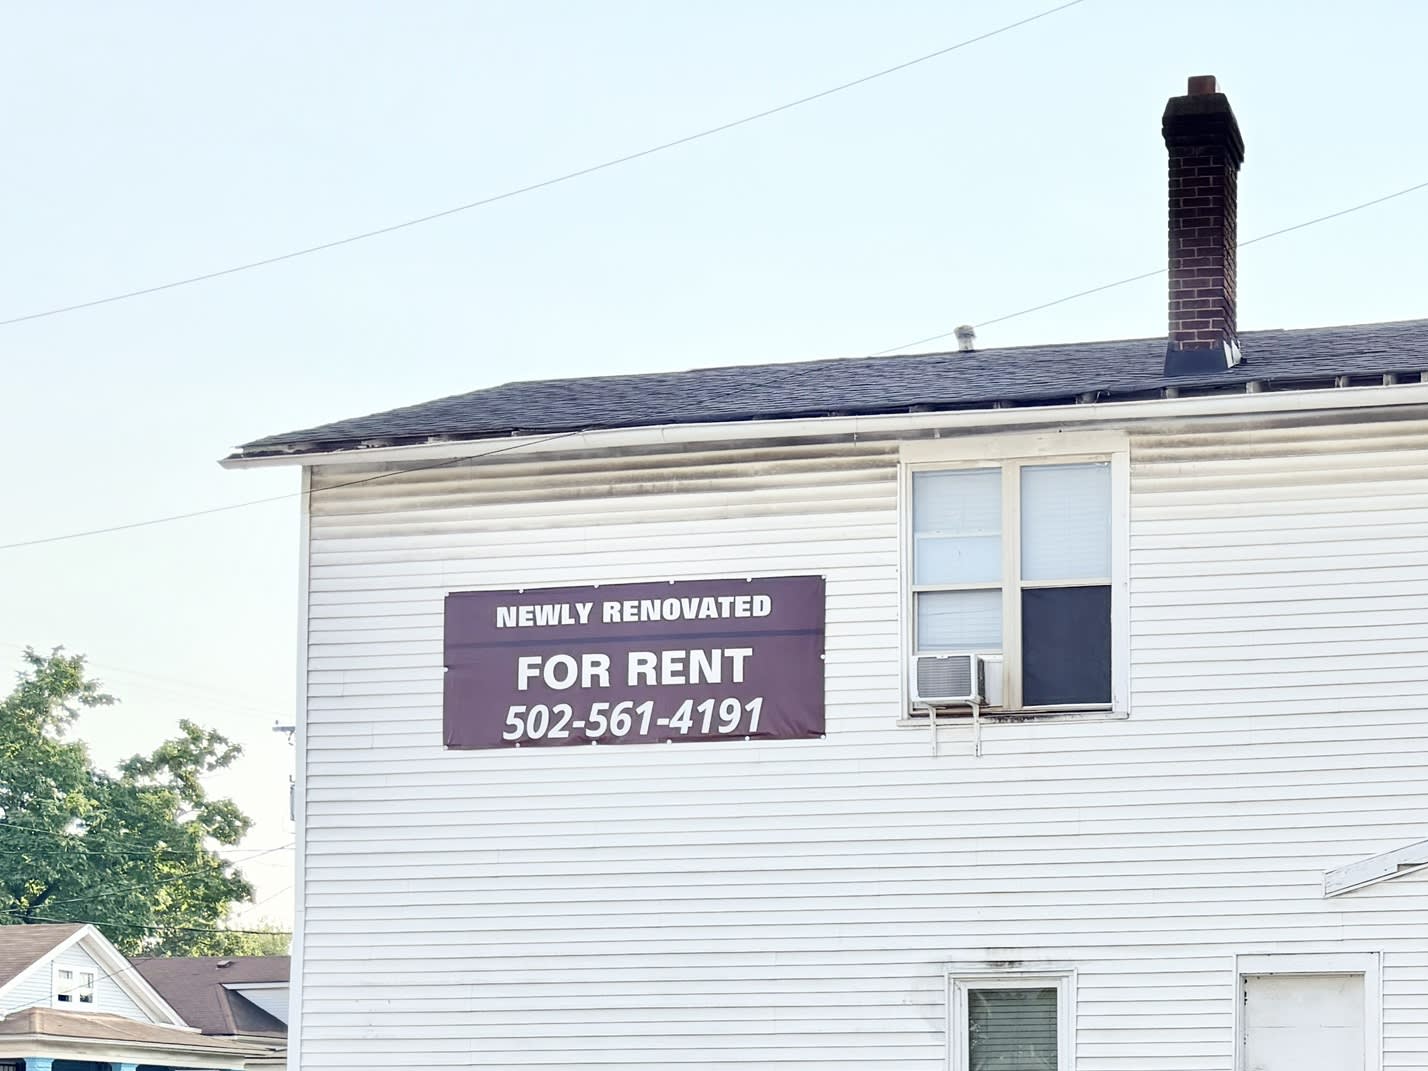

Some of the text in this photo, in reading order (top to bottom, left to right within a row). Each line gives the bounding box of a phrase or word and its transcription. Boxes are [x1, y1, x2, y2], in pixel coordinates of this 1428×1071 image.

[496, 595, 772, 628] NEWLY RENOVATED
[517, 647, 753, 691] FOR RENT
[502, 697, 764, 740] 502-561-4191
